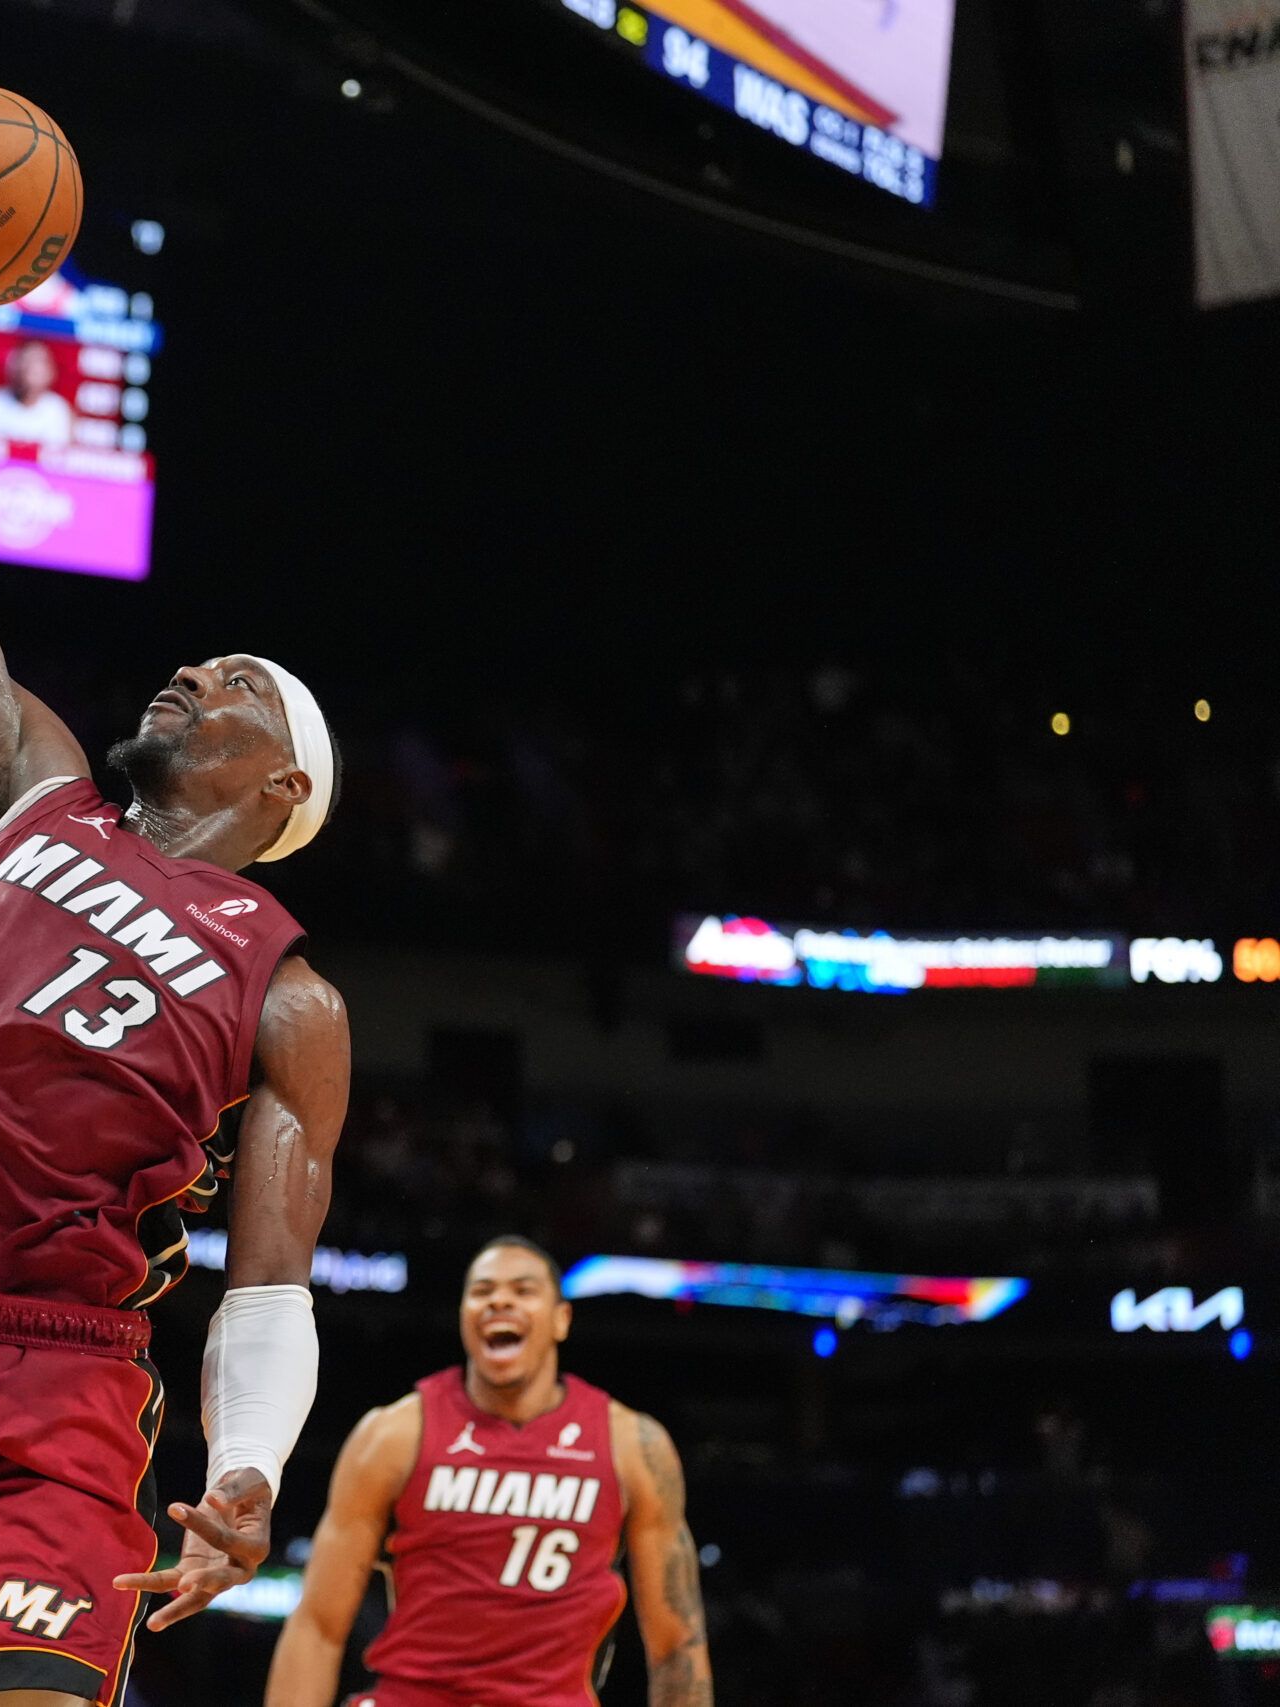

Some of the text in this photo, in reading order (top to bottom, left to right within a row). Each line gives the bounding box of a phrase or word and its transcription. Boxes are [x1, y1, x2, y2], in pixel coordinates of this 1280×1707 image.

[186, 903, 249, 948] Robinhood
[19, 946, 160, 1050] 13
[423, 1465, 600, 1524] MIAMI
[499, 1525, 580, 1592] 16
